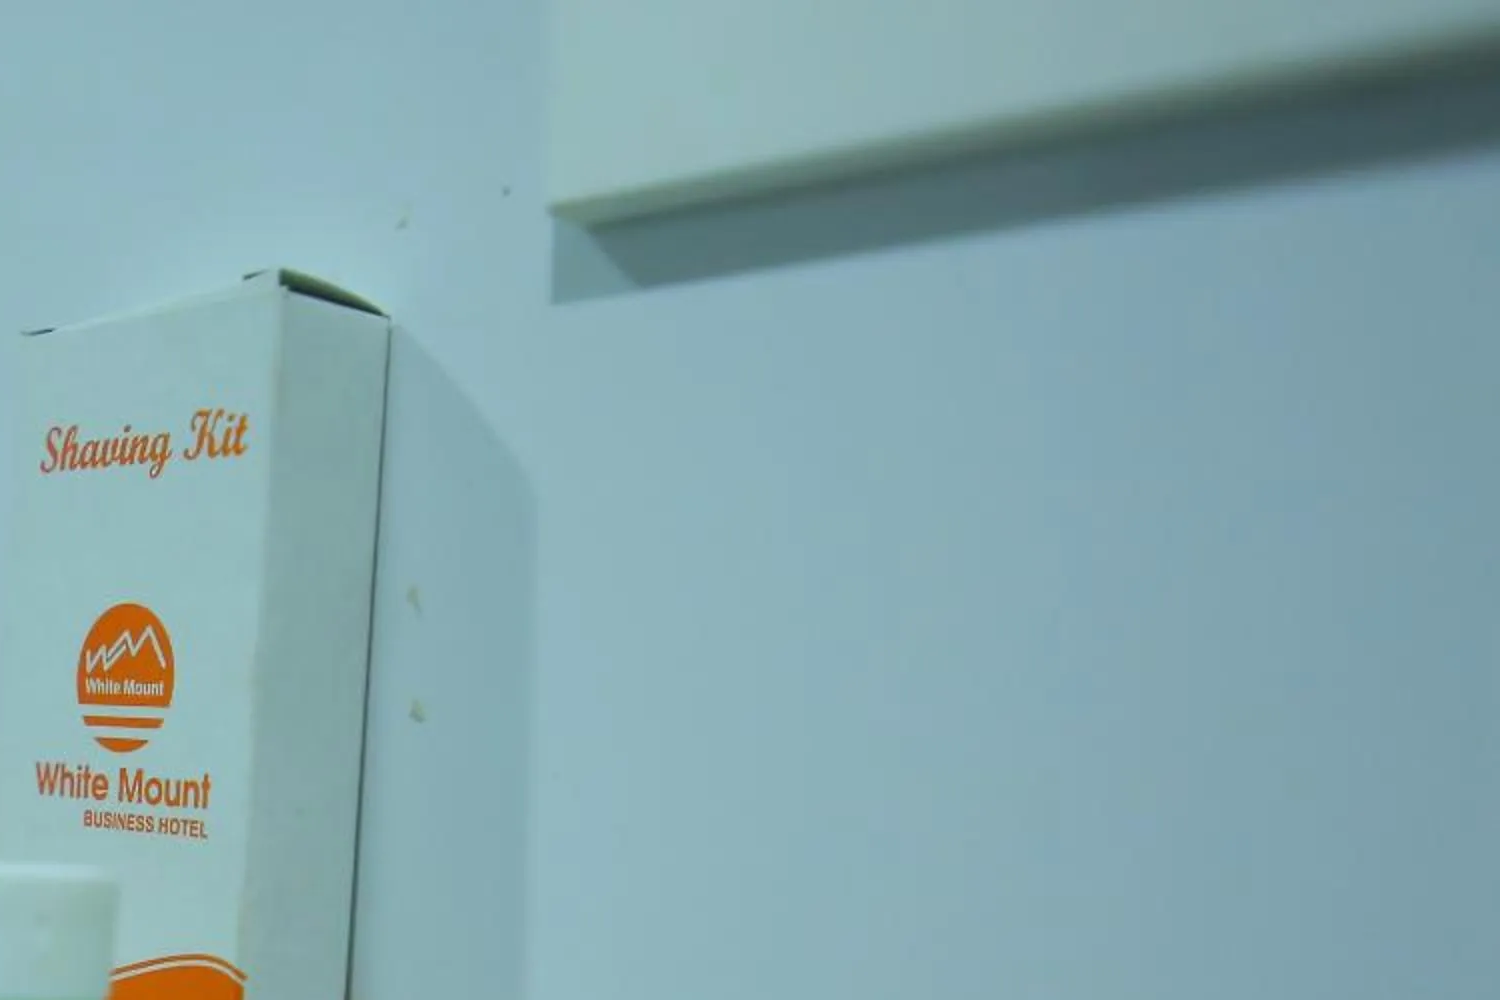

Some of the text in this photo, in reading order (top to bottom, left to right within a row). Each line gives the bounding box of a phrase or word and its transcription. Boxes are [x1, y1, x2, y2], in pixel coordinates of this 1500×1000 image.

[40, 407, 248, 479] Shaving Kit
[85, 677, 164, 696] White Mount
[35, 761, 211, 809] White Mount
[83, 810, 208, 839] BUSINESS HOTEL
